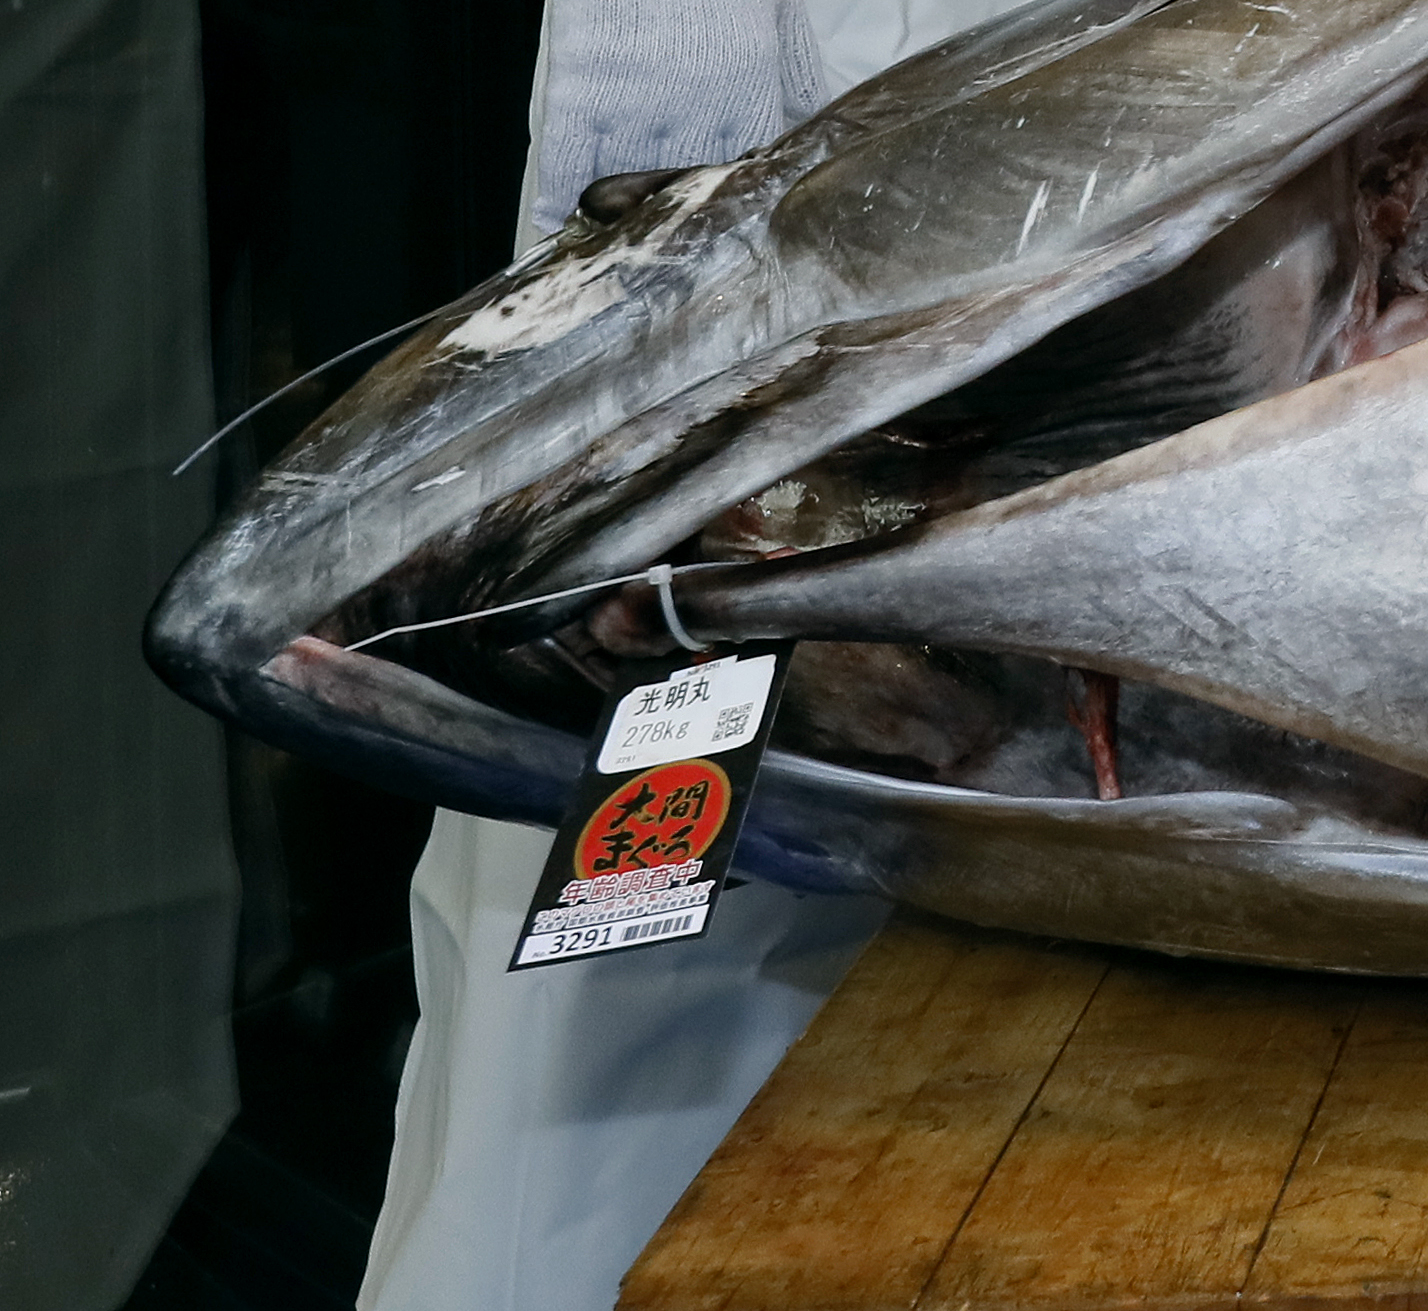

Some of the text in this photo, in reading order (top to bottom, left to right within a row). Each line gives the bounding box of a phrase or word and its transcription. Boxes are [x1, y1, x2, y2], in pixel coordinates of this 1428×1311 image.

[634, 677, 711, 716] 光明丸
[621, 720, 691, 748] 278kg
[610, 779, 710, 830] 大間
[593, 824, 695, 872] まぐろ
[560, 859, 703, 904] 年齢調査中
[549, 926, 613, 954] 3291
